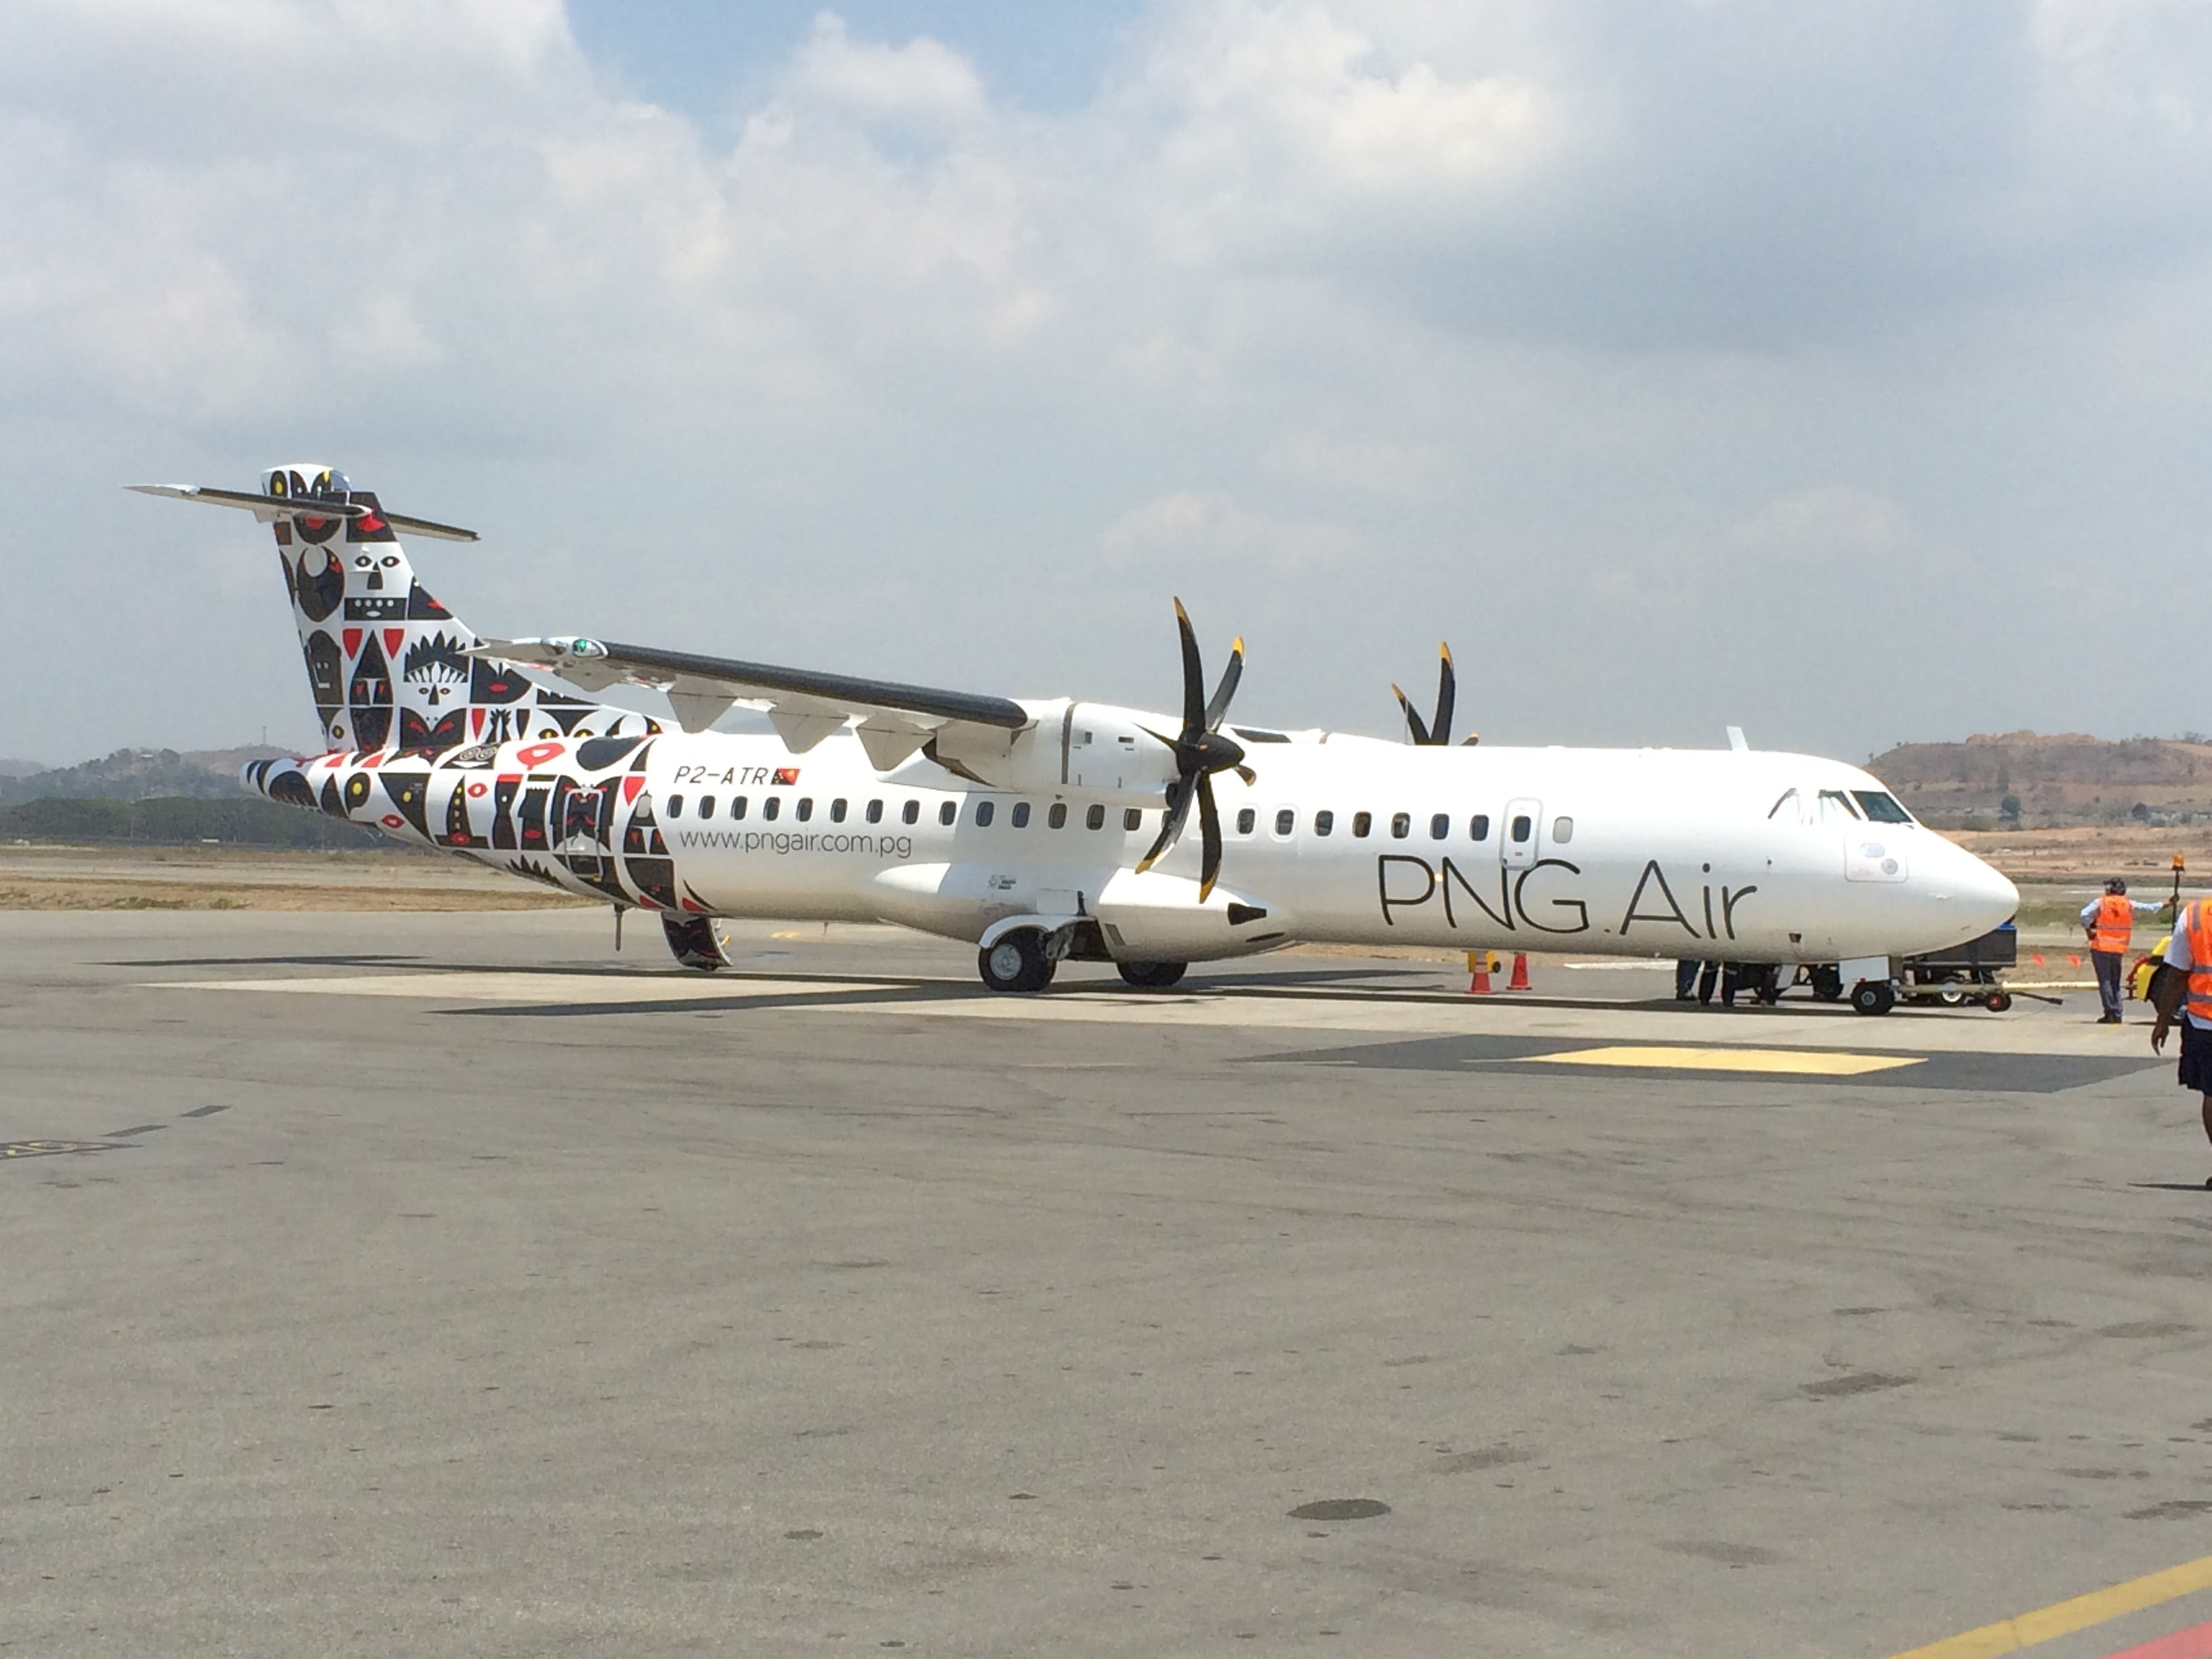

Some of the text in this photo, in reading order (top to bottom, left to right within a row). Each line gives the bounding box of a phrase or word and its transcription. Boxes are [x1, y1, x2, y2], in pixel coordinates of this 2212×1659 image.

[673, 765, 769, 785] P2-ATR
[679, 827, 912, 859] www.pngair.com.pg
[1378, 854, 1758, 941] PNG Air
